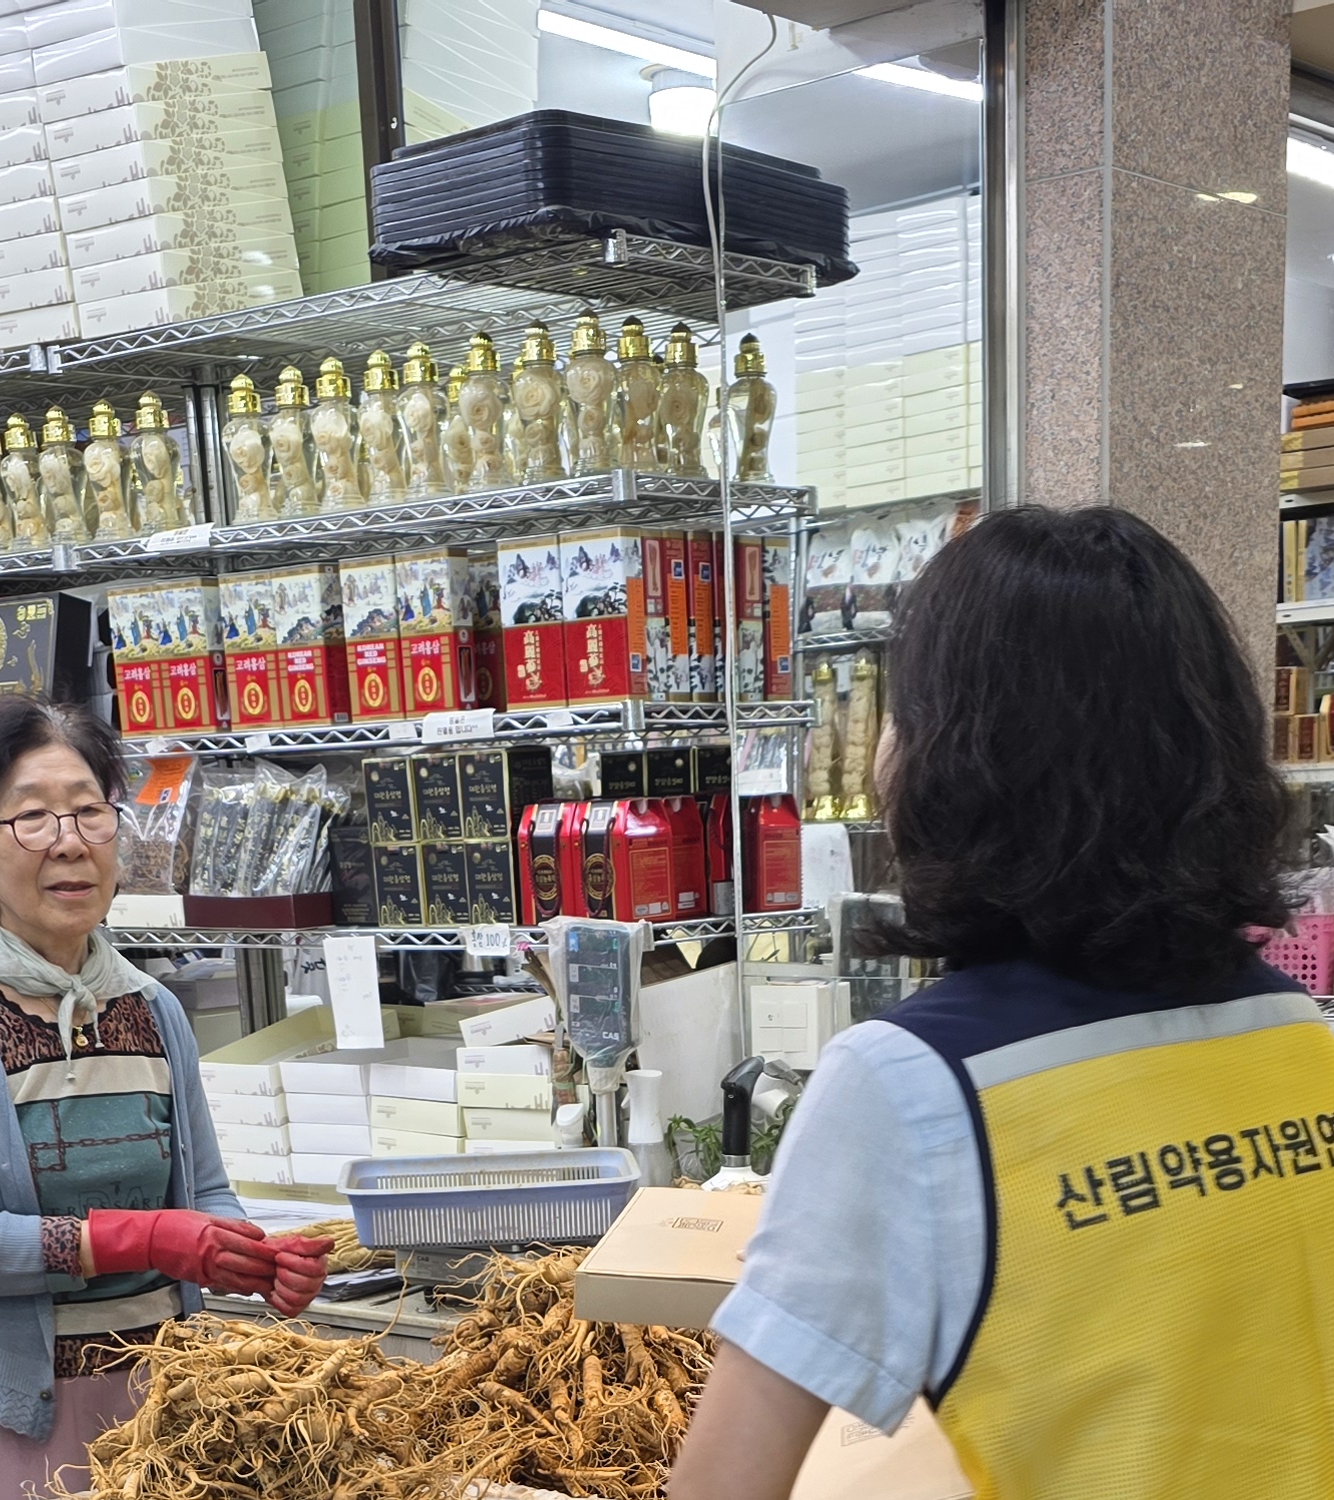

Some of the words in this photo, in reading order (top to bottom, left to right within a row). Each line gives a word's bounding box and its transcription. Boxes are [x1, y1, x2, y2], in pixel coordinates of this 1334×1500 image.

[411, 640, 440, 655] 고려홍삼
[170, 662, 197, 677] 고려홍삼
[236, 656, 266, 671] 고려홍삼
[602, 1031, 620, 1041] CAS
